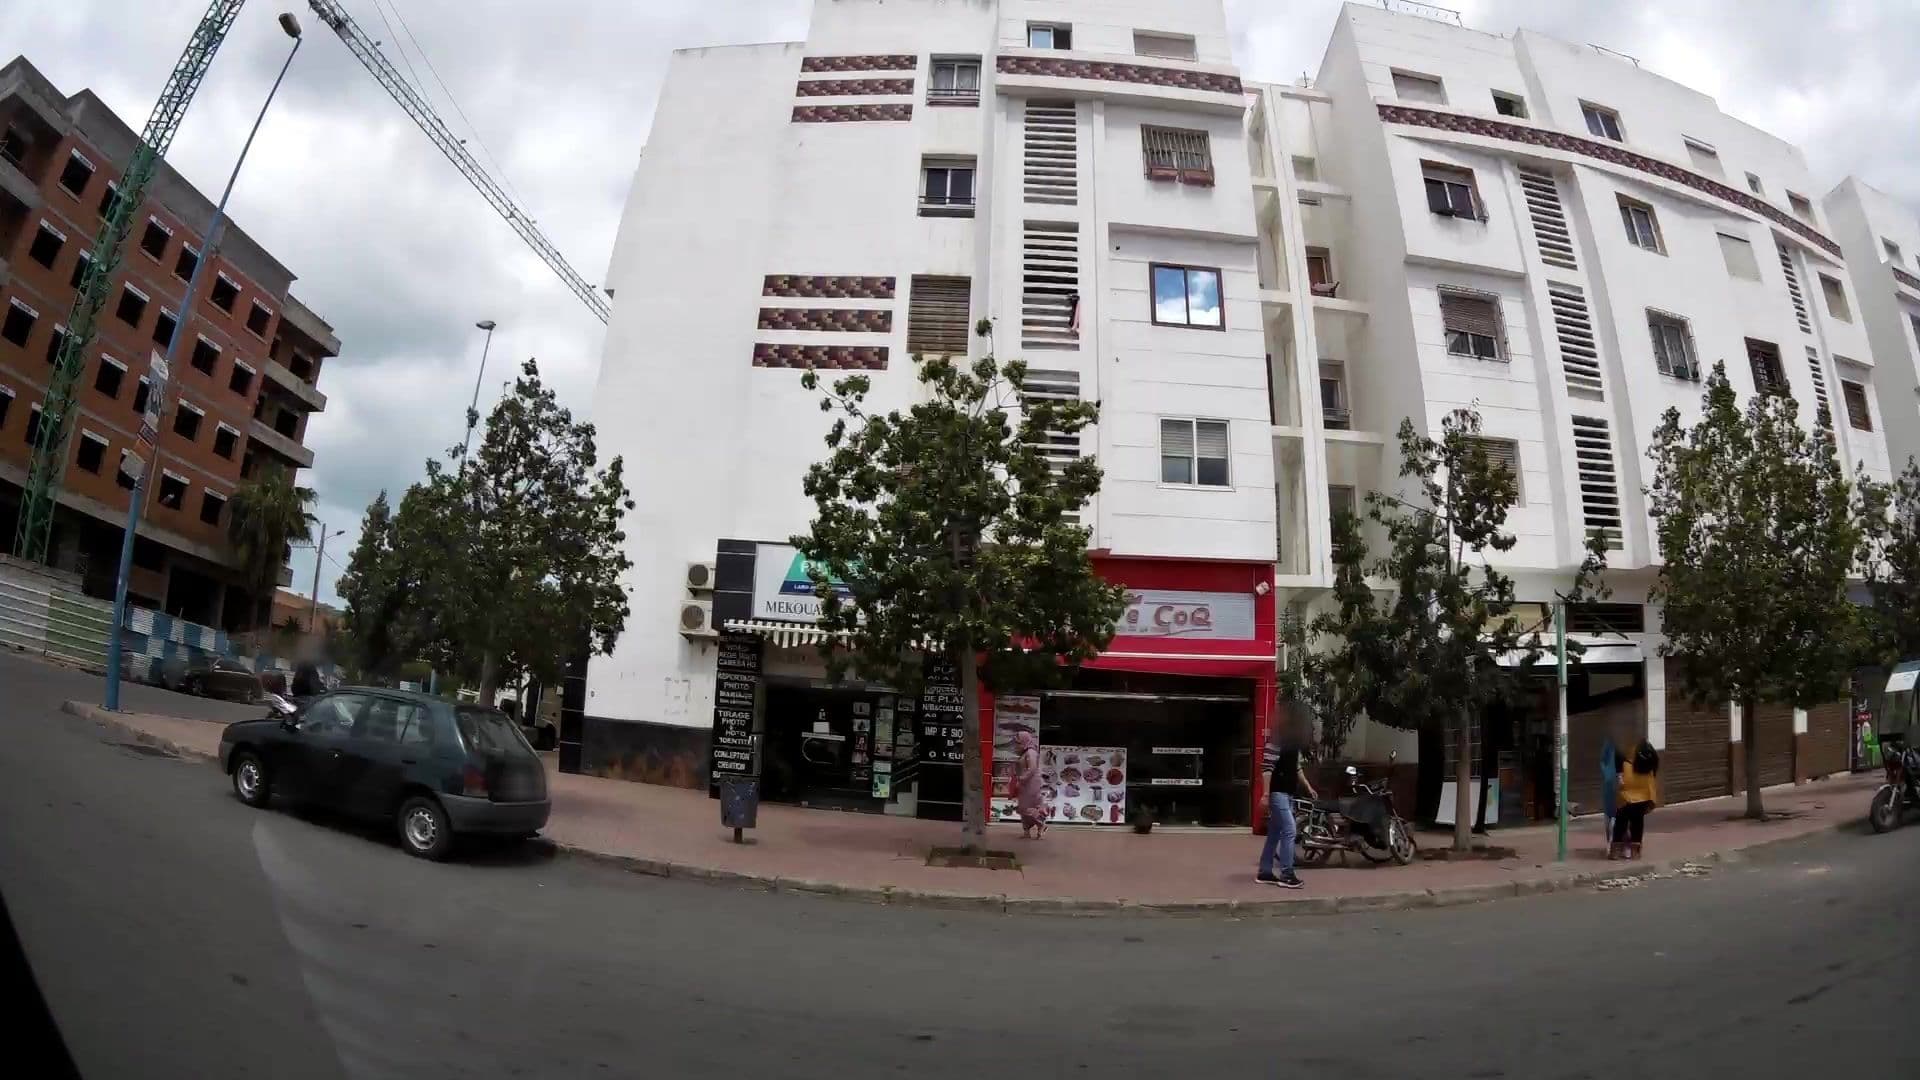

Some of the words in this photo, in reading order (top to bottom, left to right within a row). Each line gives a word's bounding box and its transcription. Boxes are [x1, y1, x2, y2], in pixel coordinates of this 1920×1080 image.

[766, 600, 821, 616] MEKOUA
[723, 681, 750, 691] PHOTO
[718, 710, 751, 720] TIRAGE
[721, 718, 746, 726] PHOTO
[717, 761, 746, 770] CREATION
